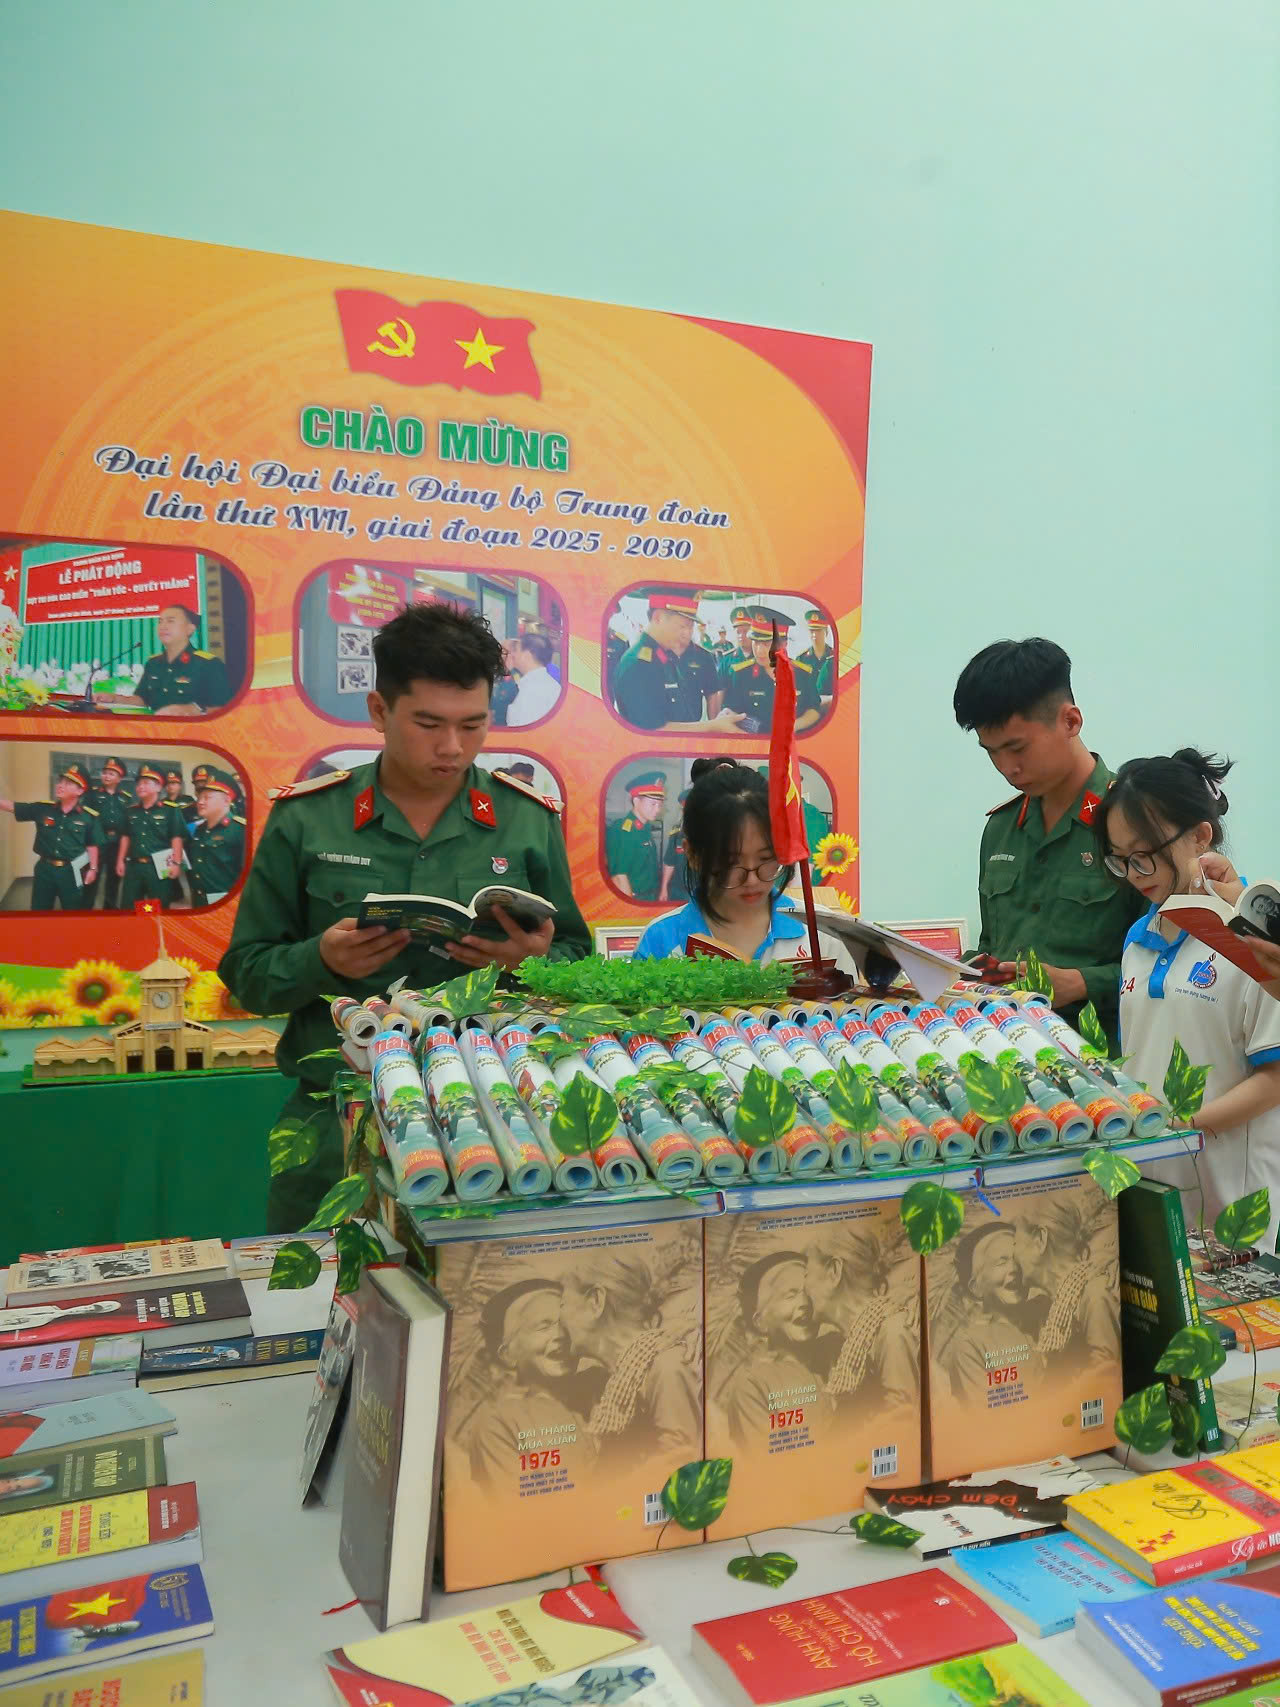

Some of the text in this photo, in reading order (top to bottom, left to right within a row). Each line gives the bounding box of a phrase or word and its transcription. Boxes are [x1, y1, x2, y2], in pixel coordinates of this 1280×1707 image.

[301, 405, 570, 473] CHÀO MỪNG
[95, 446, 730, 528] Đại hội Đại biểu Đảng bộ Trung đoàn
[145, 492, 206, 521] lần
[216, 500, 278, 528] thứ
[367, 517, 432, 542] giai
[441, 517, 521, 550] đoạn
[530, 528, 601, 554] 2025
[624, 536, 692, 560] 2030
[73, 564, 103, 583] PHÁT
[105, 560, 142, 580] ĐỘNG
[987, 1367, 1018, 1386] 1975
[769, 1408, 804, 1430] 1975
[518, 1449, 561, 1471] 1975
[799, 1598, 842, 1626] MINH
[764, 1612, 838, 1671] ANH HÙNG
[843, 1644, 882, 1668] HỒ
